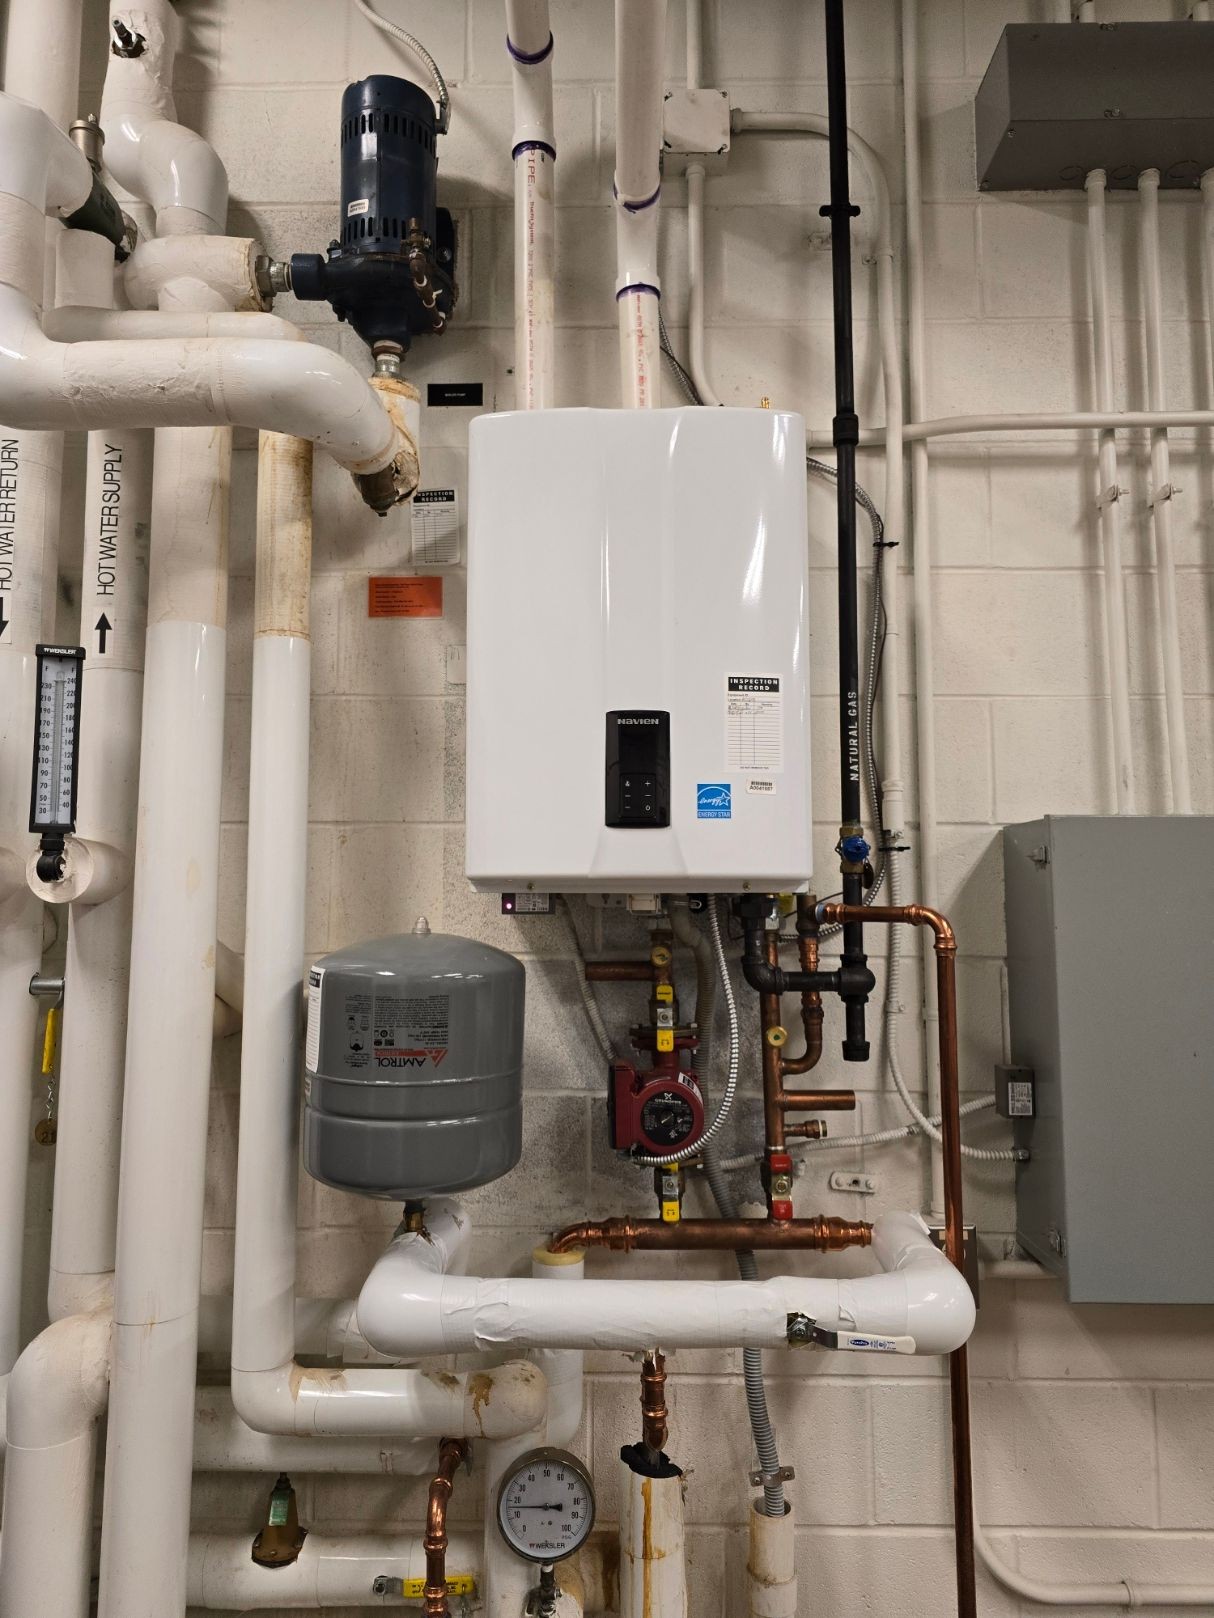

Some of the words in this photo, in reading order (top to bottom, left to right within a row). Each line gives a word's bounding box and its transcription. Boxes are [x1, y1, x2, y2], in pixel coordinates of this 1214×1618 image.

[0, 439, 19, 500] RETURN
[102, 443, 123, 503] SUPPLY
[99, 505, 119, 562] WATER
[97, 562, 116, 596] HOT
[847, 691, 857, 717] GAS
[848, 721, 859, 781] NATURAL
[39, 794, 47, 802] 50
[374, 1057, 426, 1068] AMTROL
[543, 1469, 551, 1477] 50
[556, 1473, 564, 1481] 60
[527, 1474, 535, 1482] 40
[519, 1484, 526, 1492] 30
[567, 1482, 575, 1490] 70
[514, 1496, 521, 1504] 20
[573, 1497, 580, 1505] 80
[514, 1511, 521, 1519] 10
[571, 1511, 579, 1519] 90
[522, 1524, 527, 1533] 0
[561, 1524, 571, 1532] 100
